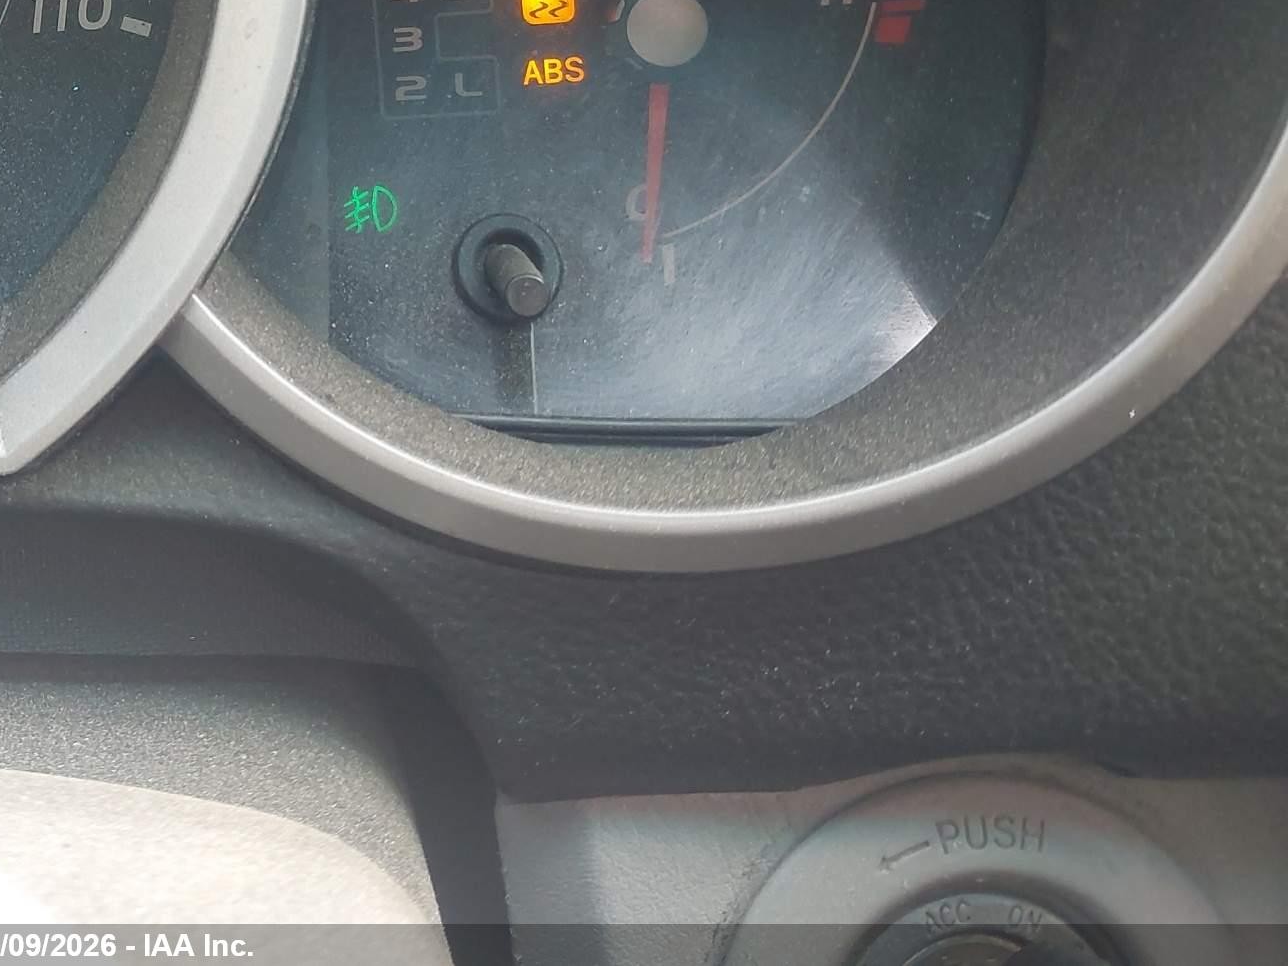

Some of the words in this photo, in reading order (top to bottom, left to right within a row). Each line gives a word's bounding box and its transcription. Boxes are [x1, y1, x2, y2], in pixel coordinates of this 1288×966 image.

[392, 26, 423, 51] 3
[453, 72, 483, 96] L
[523, 57, 585, 85] ABS
[394, 76, 427, 101] 2
[934, 814, 1045, 854] PUSH
[925, 898, 971, 933] ACC
